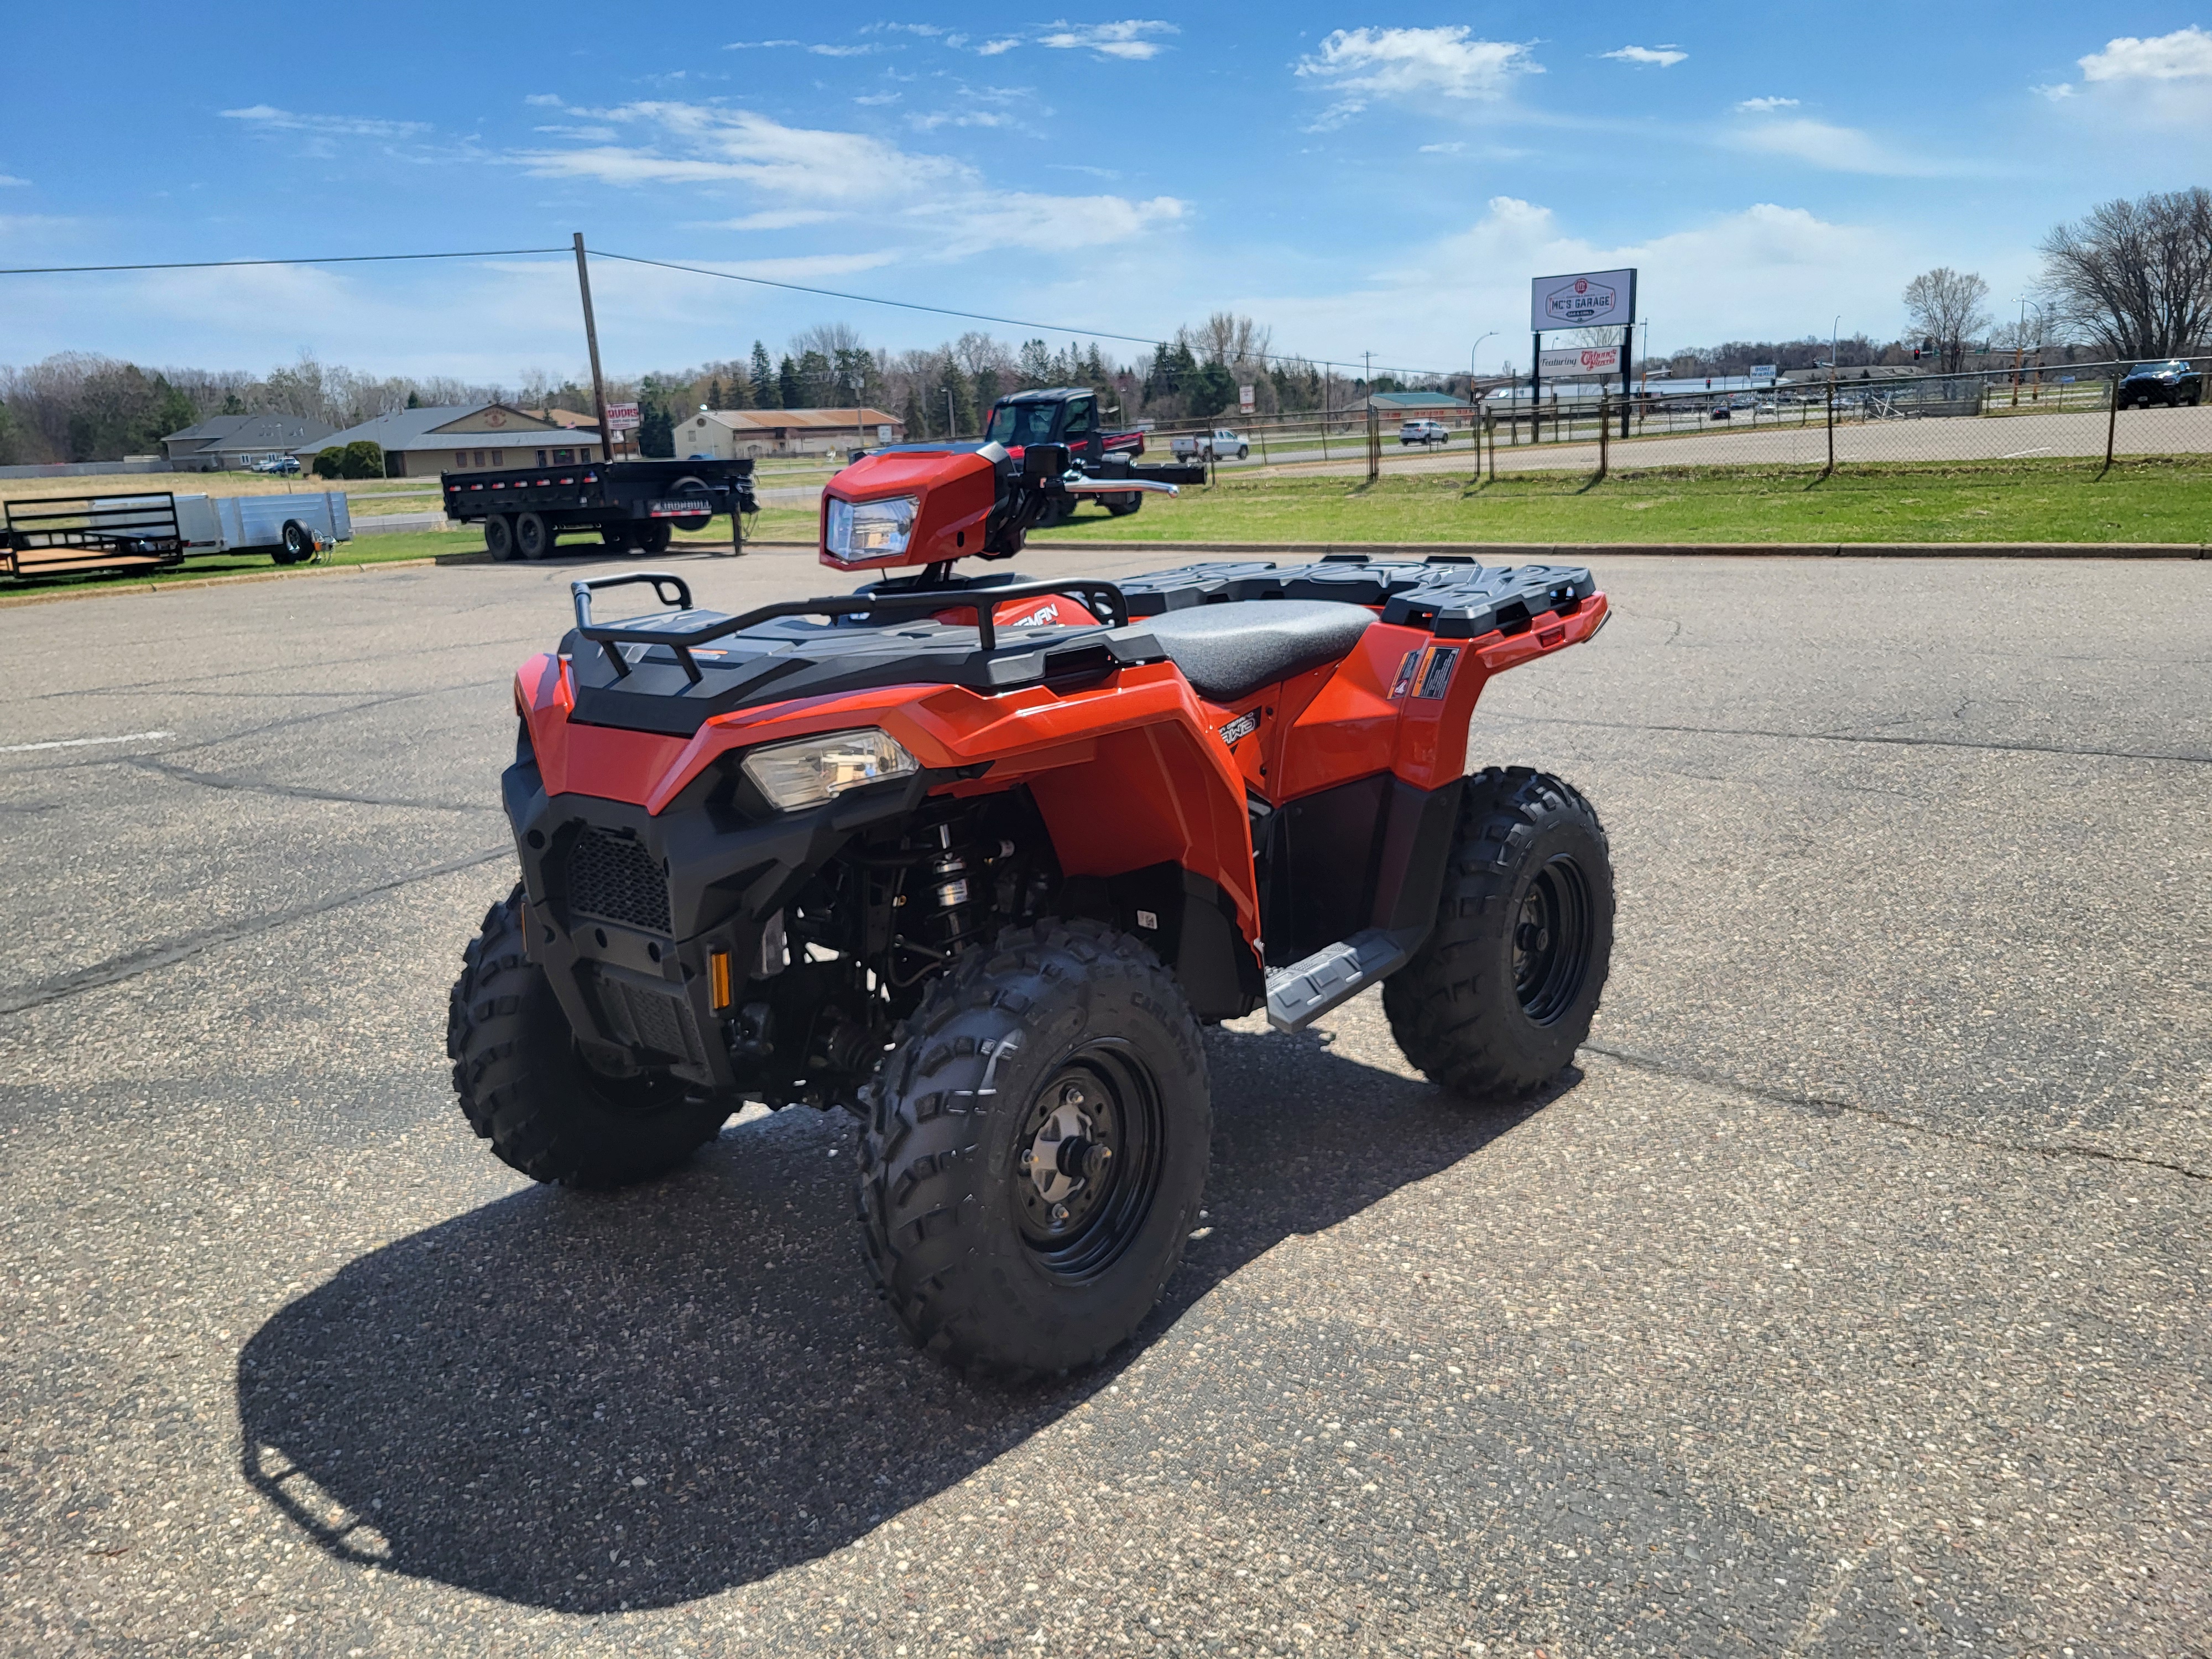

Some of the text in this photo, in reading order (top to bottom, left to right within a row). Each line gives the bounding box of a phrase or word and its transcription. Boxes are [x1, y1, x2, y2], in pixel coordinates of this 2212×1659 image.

[1552, 299, 1572, 310] MC'S
[1575, 296, 1610, 309] GARAGE
[1540, 357, 1577, 368] Featuring
